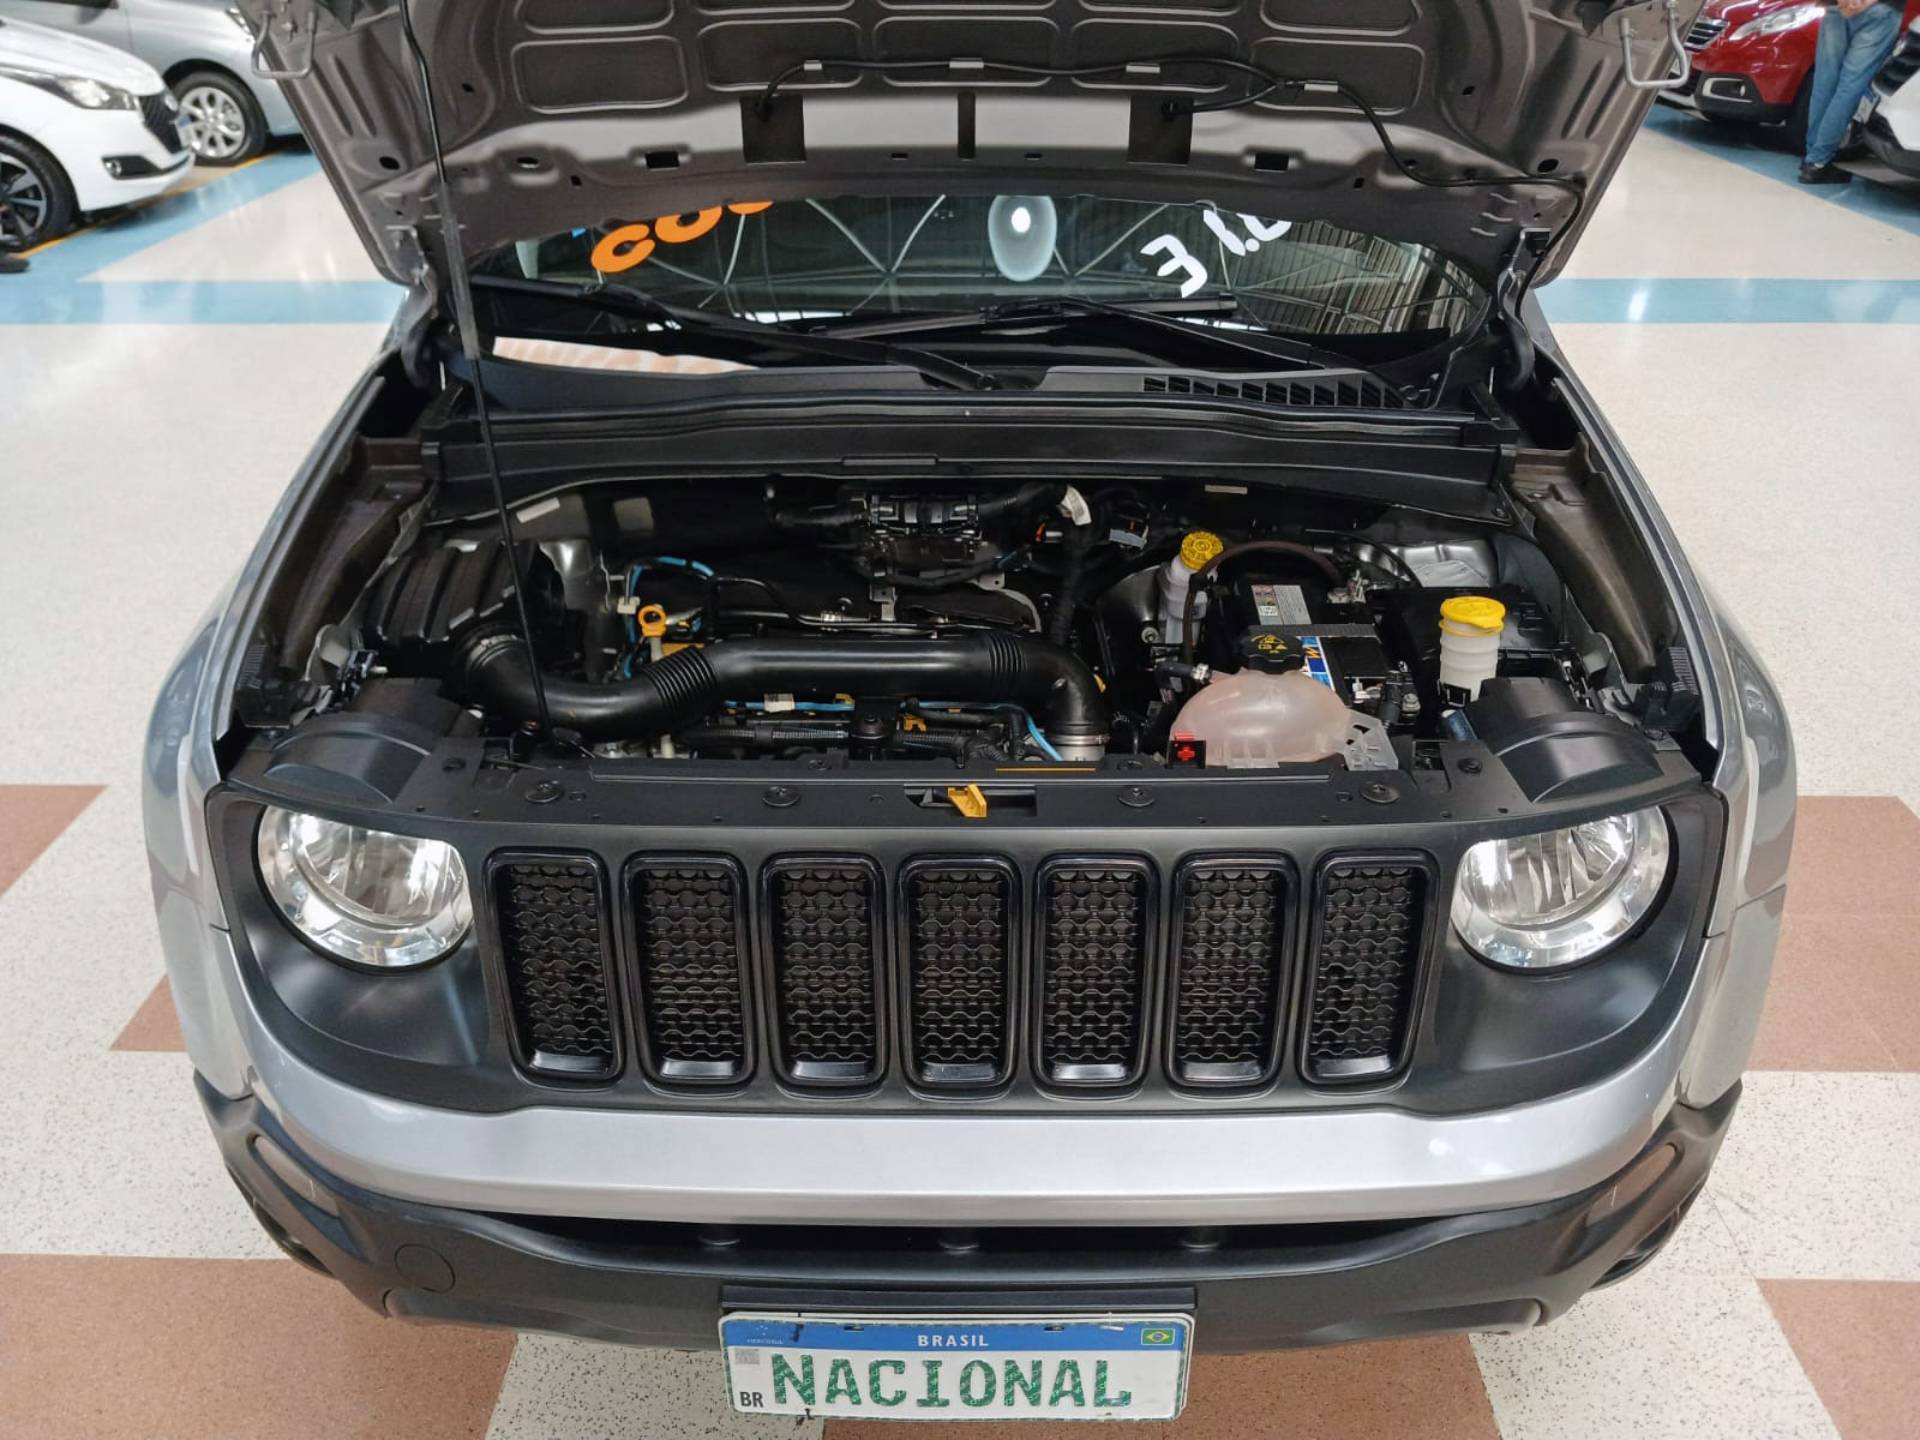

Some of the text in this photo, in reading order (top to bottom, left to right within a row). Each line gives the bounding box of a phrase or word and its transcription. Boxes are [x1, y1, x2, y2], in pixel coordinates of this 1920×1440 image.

[917, 1334, 989, 1347] BRASIL
[771, 1353, 1132, 1407] NACIONAL
[740, 1391, 764, 1408] BR
